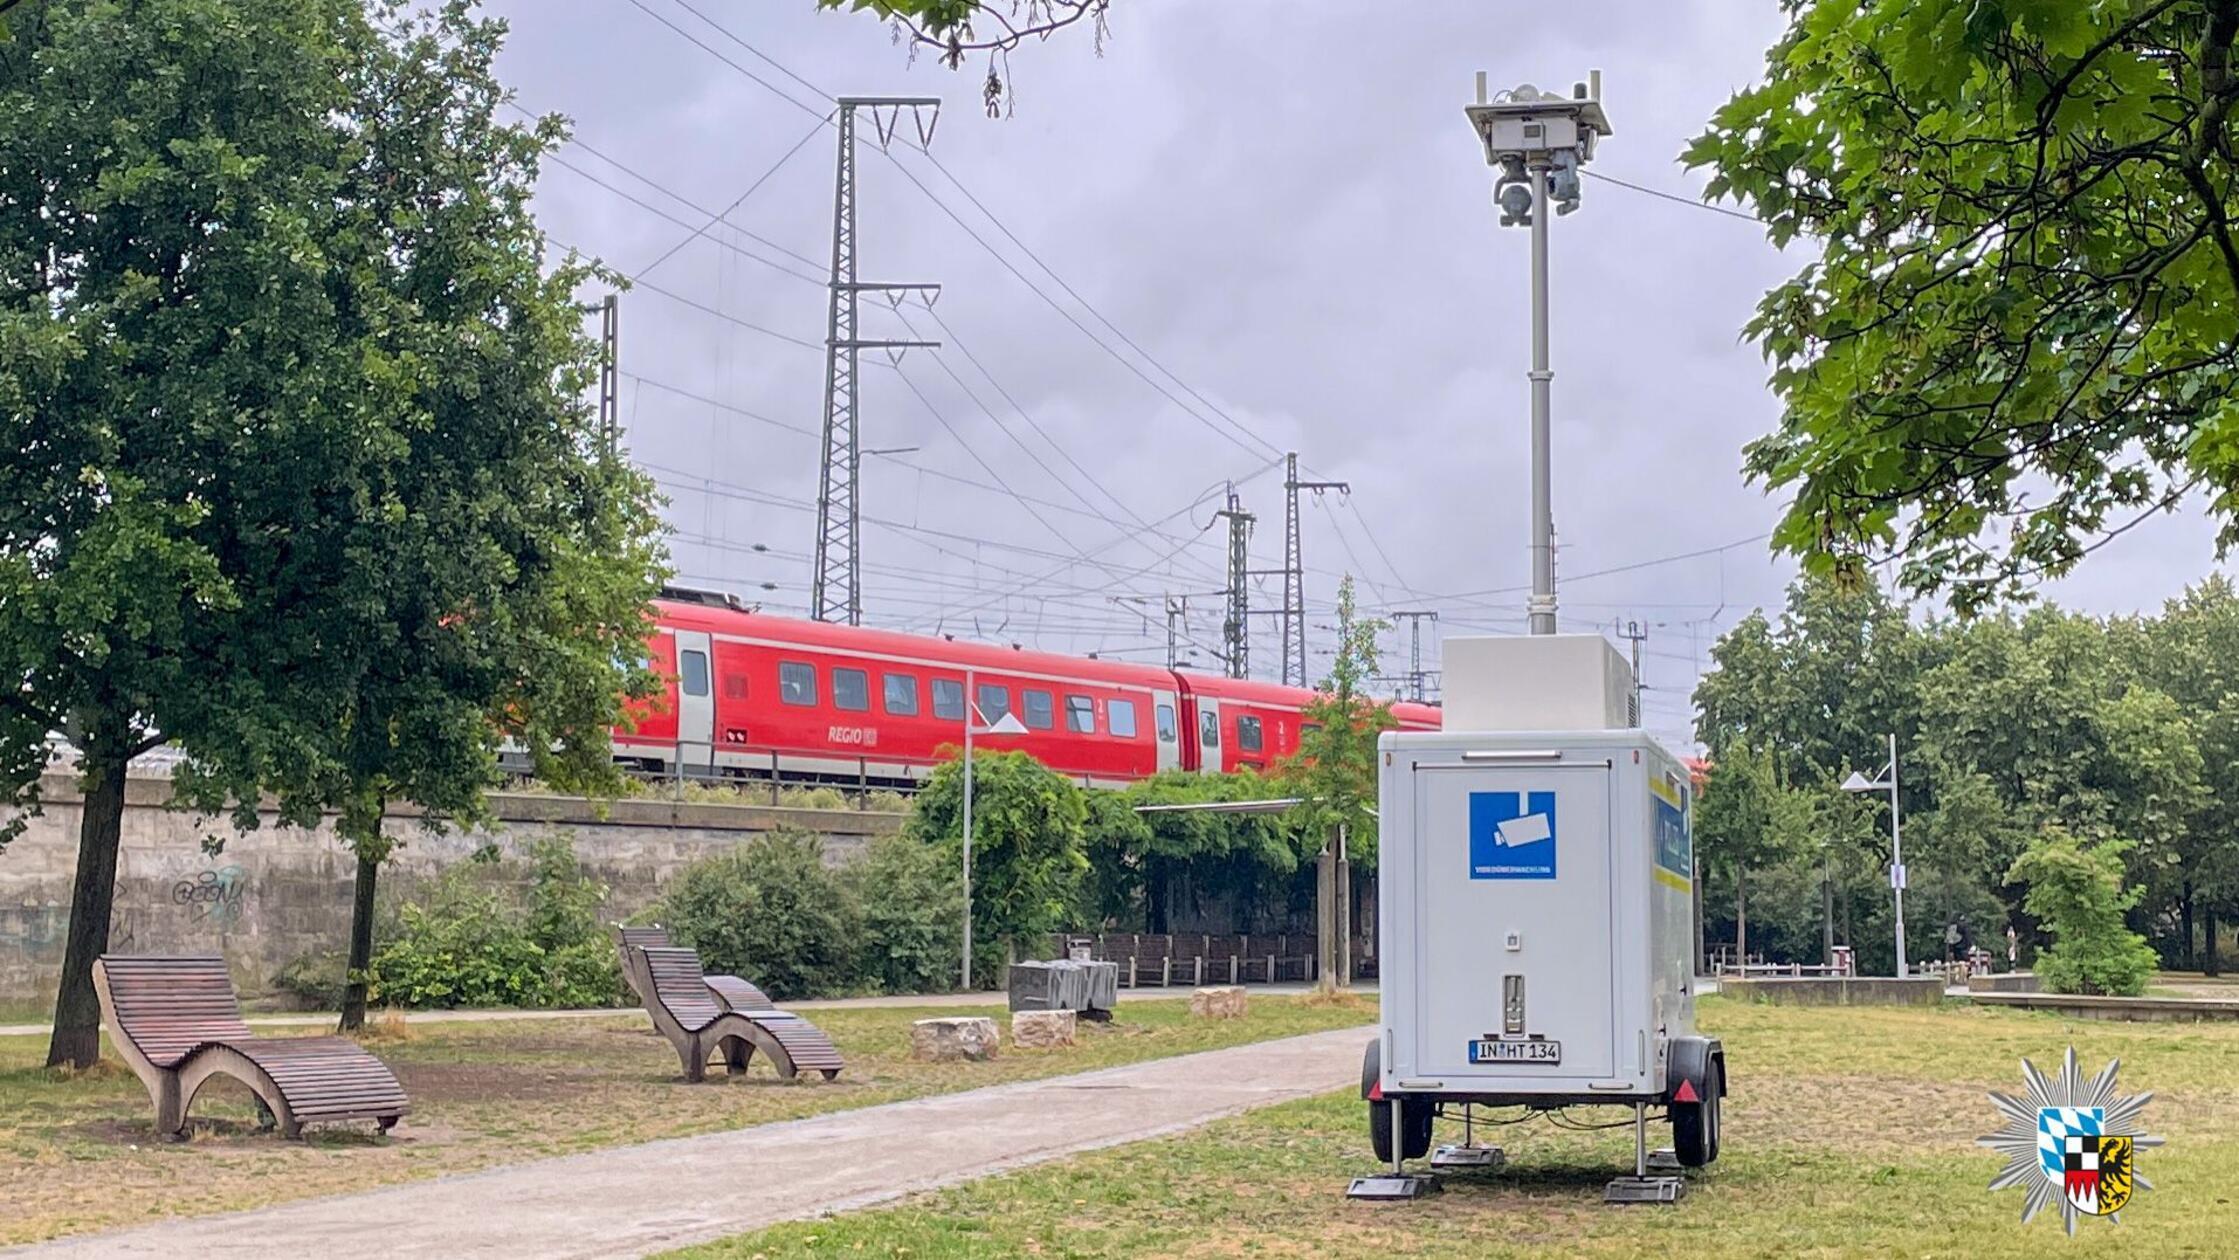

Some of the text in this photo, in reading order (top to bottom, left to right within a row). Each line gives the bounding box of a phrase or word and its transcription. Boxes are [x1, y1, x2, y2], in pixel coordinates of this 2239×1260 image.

[827, 726, 862, 744] REGIO
[1480, 1043, 1557, 1058] IN HT 134
